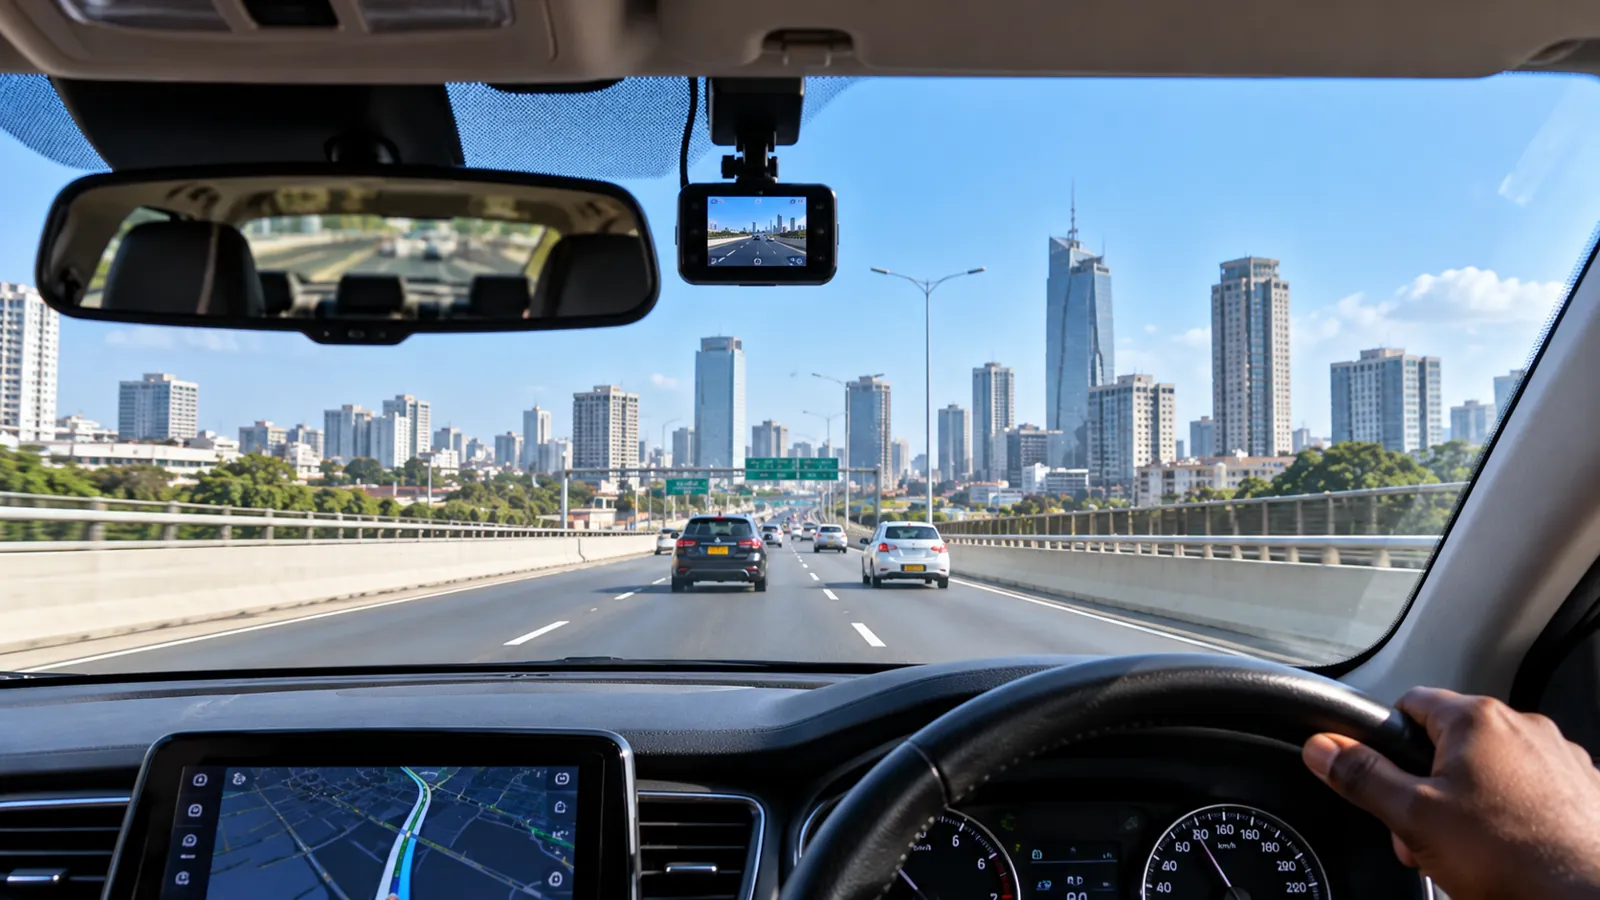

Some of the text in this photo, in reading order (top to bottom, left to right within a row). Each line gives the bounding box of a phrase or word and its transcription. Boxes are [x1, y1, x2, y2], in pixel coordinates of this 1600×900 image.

[1215, 824, 1234, 835] 160
[952, 834, 960, 847] 6
[977, 858, 986, 870] 6
